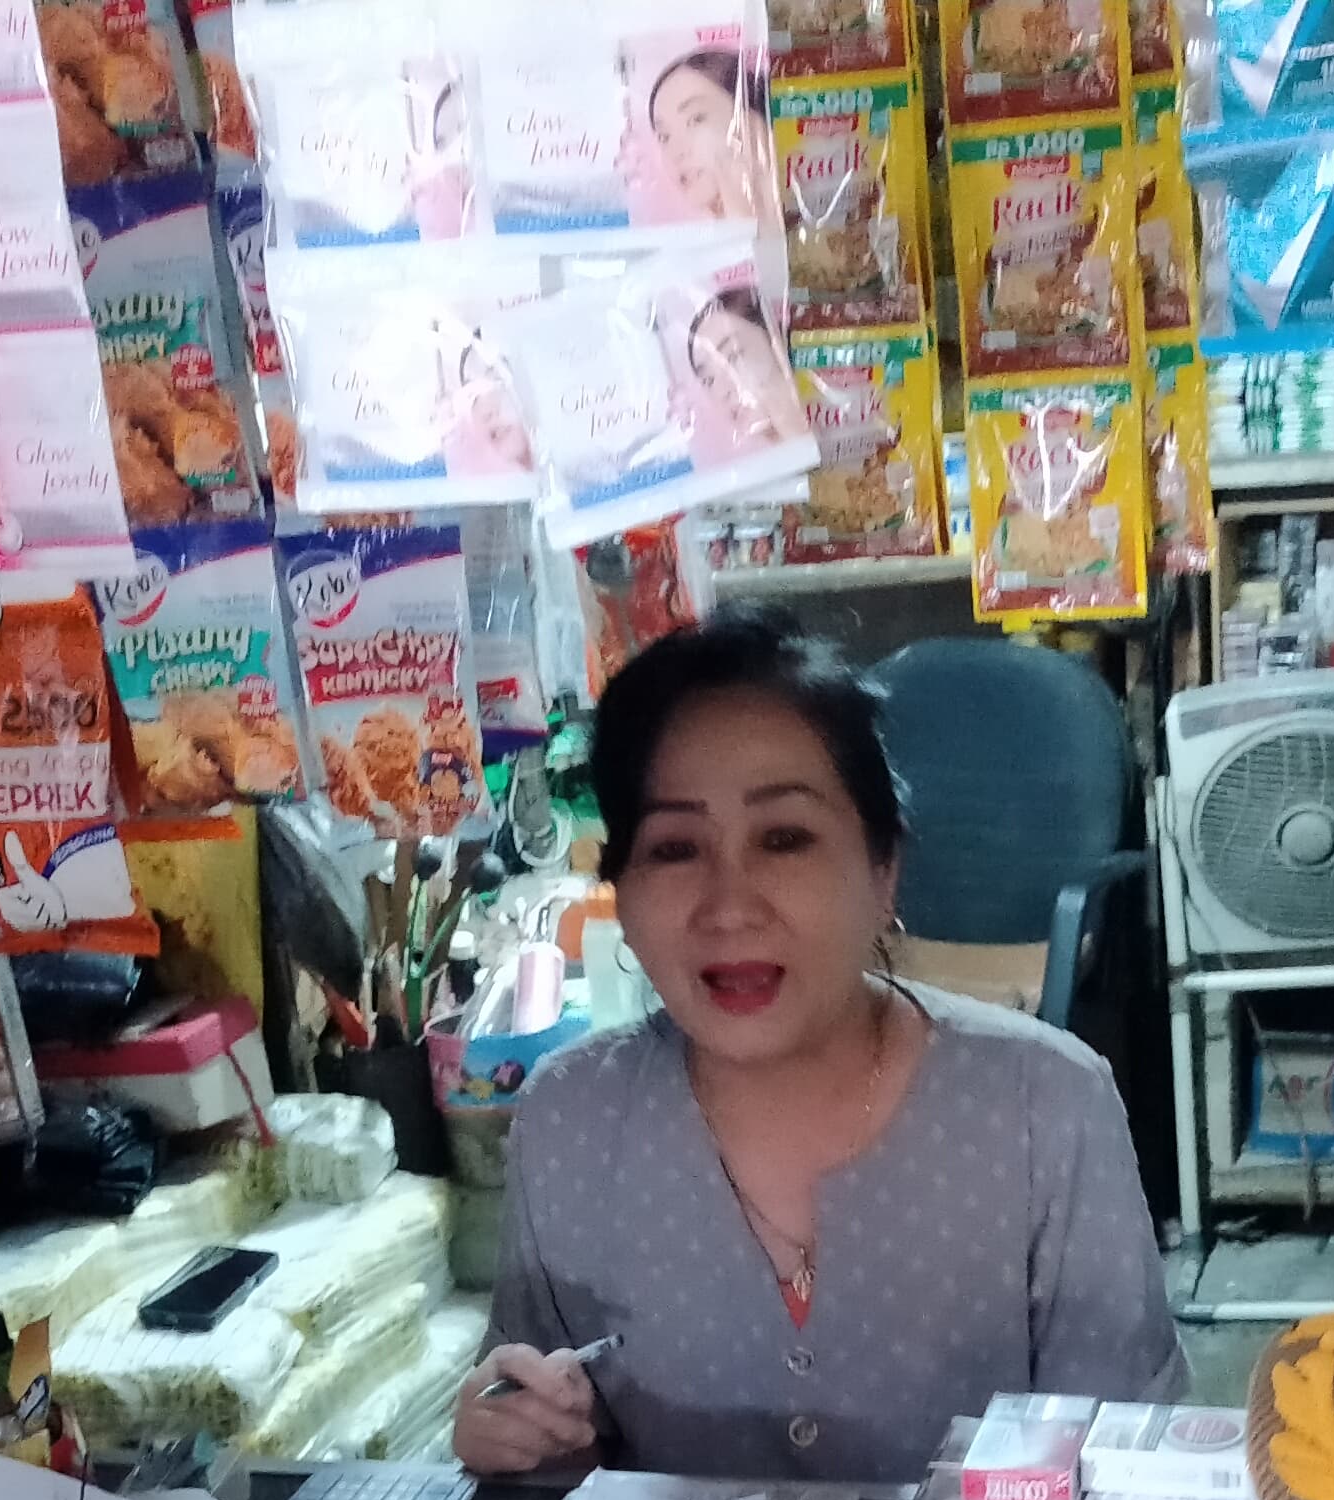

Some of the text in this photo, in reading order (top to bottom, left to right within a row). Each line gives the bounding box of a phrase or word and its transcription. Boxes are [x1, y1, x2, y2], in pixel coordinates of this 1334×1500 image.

[2, 243, 68, 279] Lovely
[17, 439, 75, 466] Glow
[43, 465, 109, 497] Lovely
